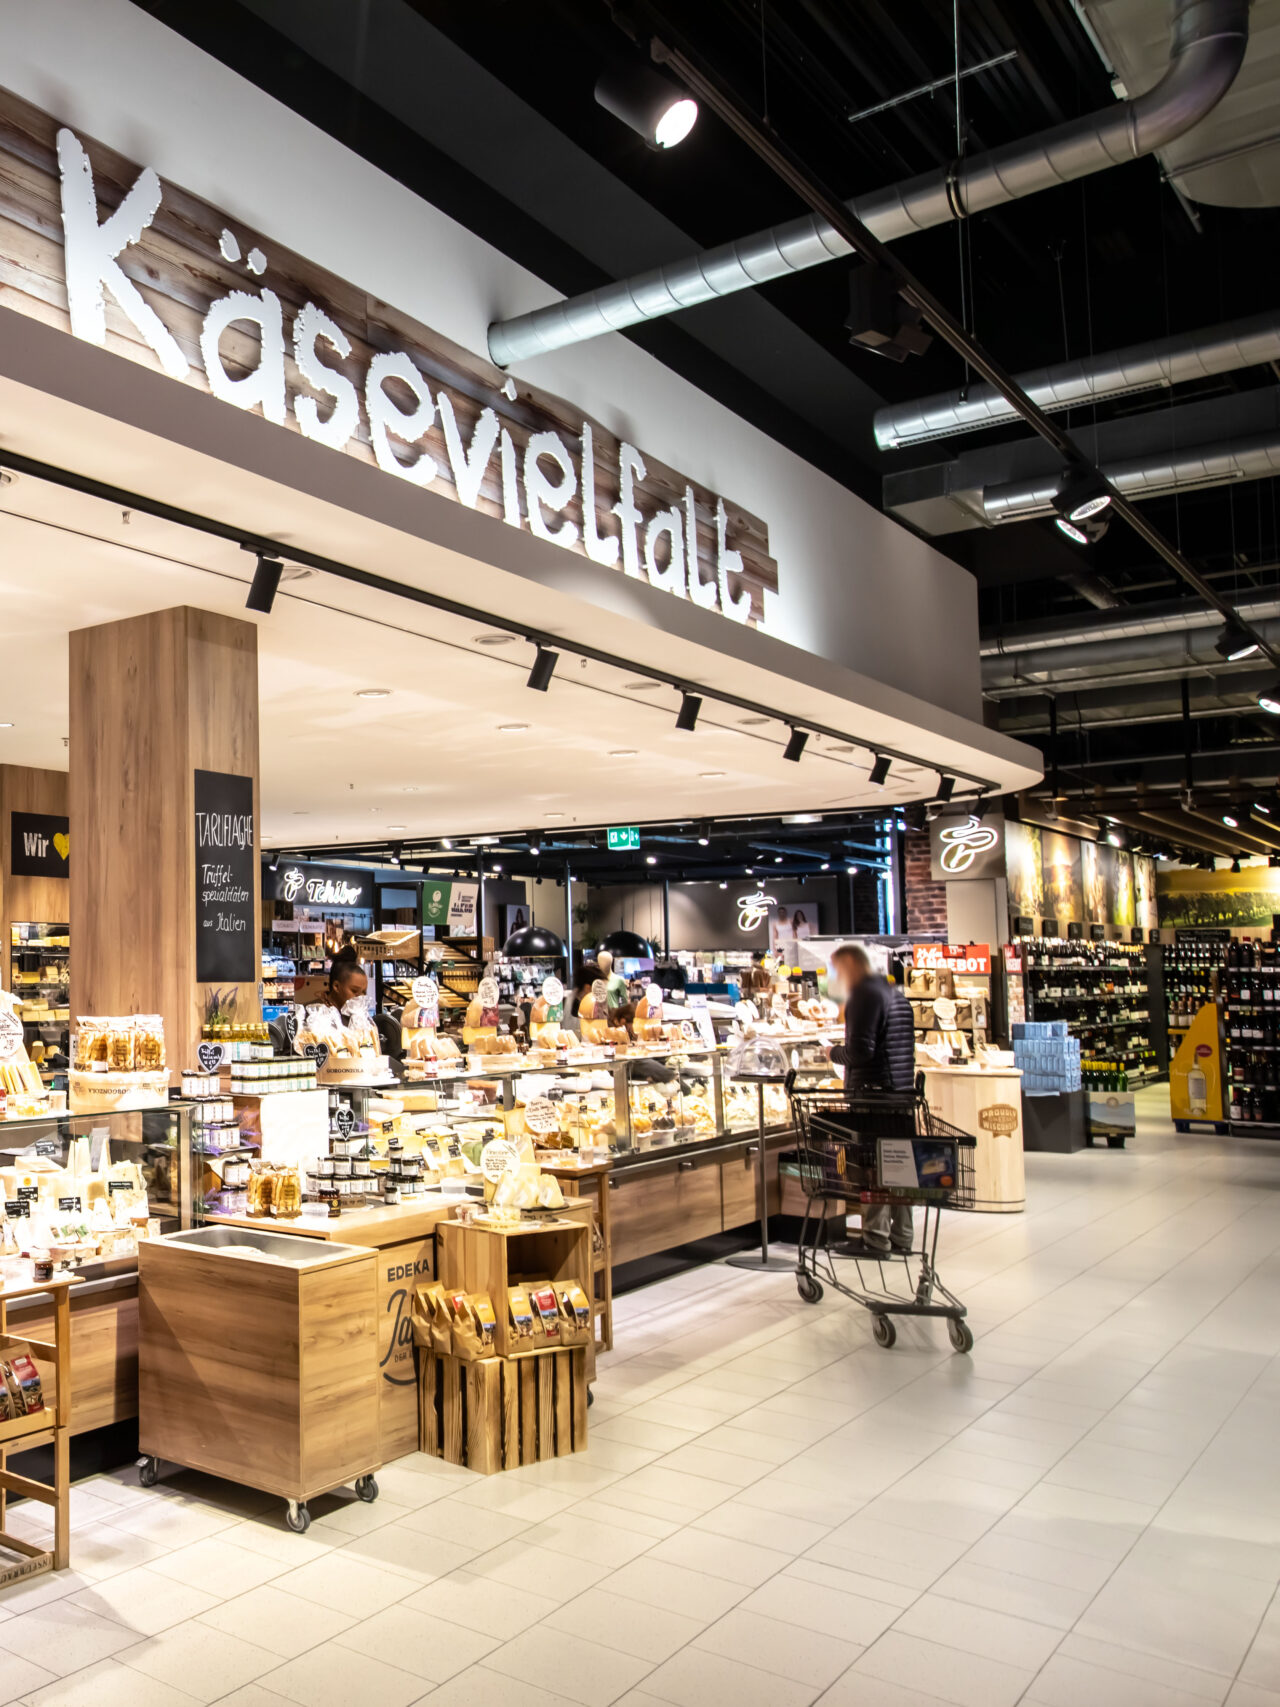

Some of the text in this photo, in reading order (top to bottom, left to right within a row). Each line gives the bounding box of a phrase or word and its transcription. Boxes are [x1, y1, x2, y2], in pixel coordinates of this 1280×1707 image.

[56, 127, 752, 614] Käsevielfalt
[23, 832, 49, 858] Wir
[201, 863, 233, 887] Trüffel-
[306, 879, 362, 905] Tchibo
[216, 912, 246, 932] Italien
[982, 1109, 1016, 1118] PROUDLY
[982, 1120, 1017, 1130] WISCONSIN
[387, 1258, 430, 1282] EDEKA
